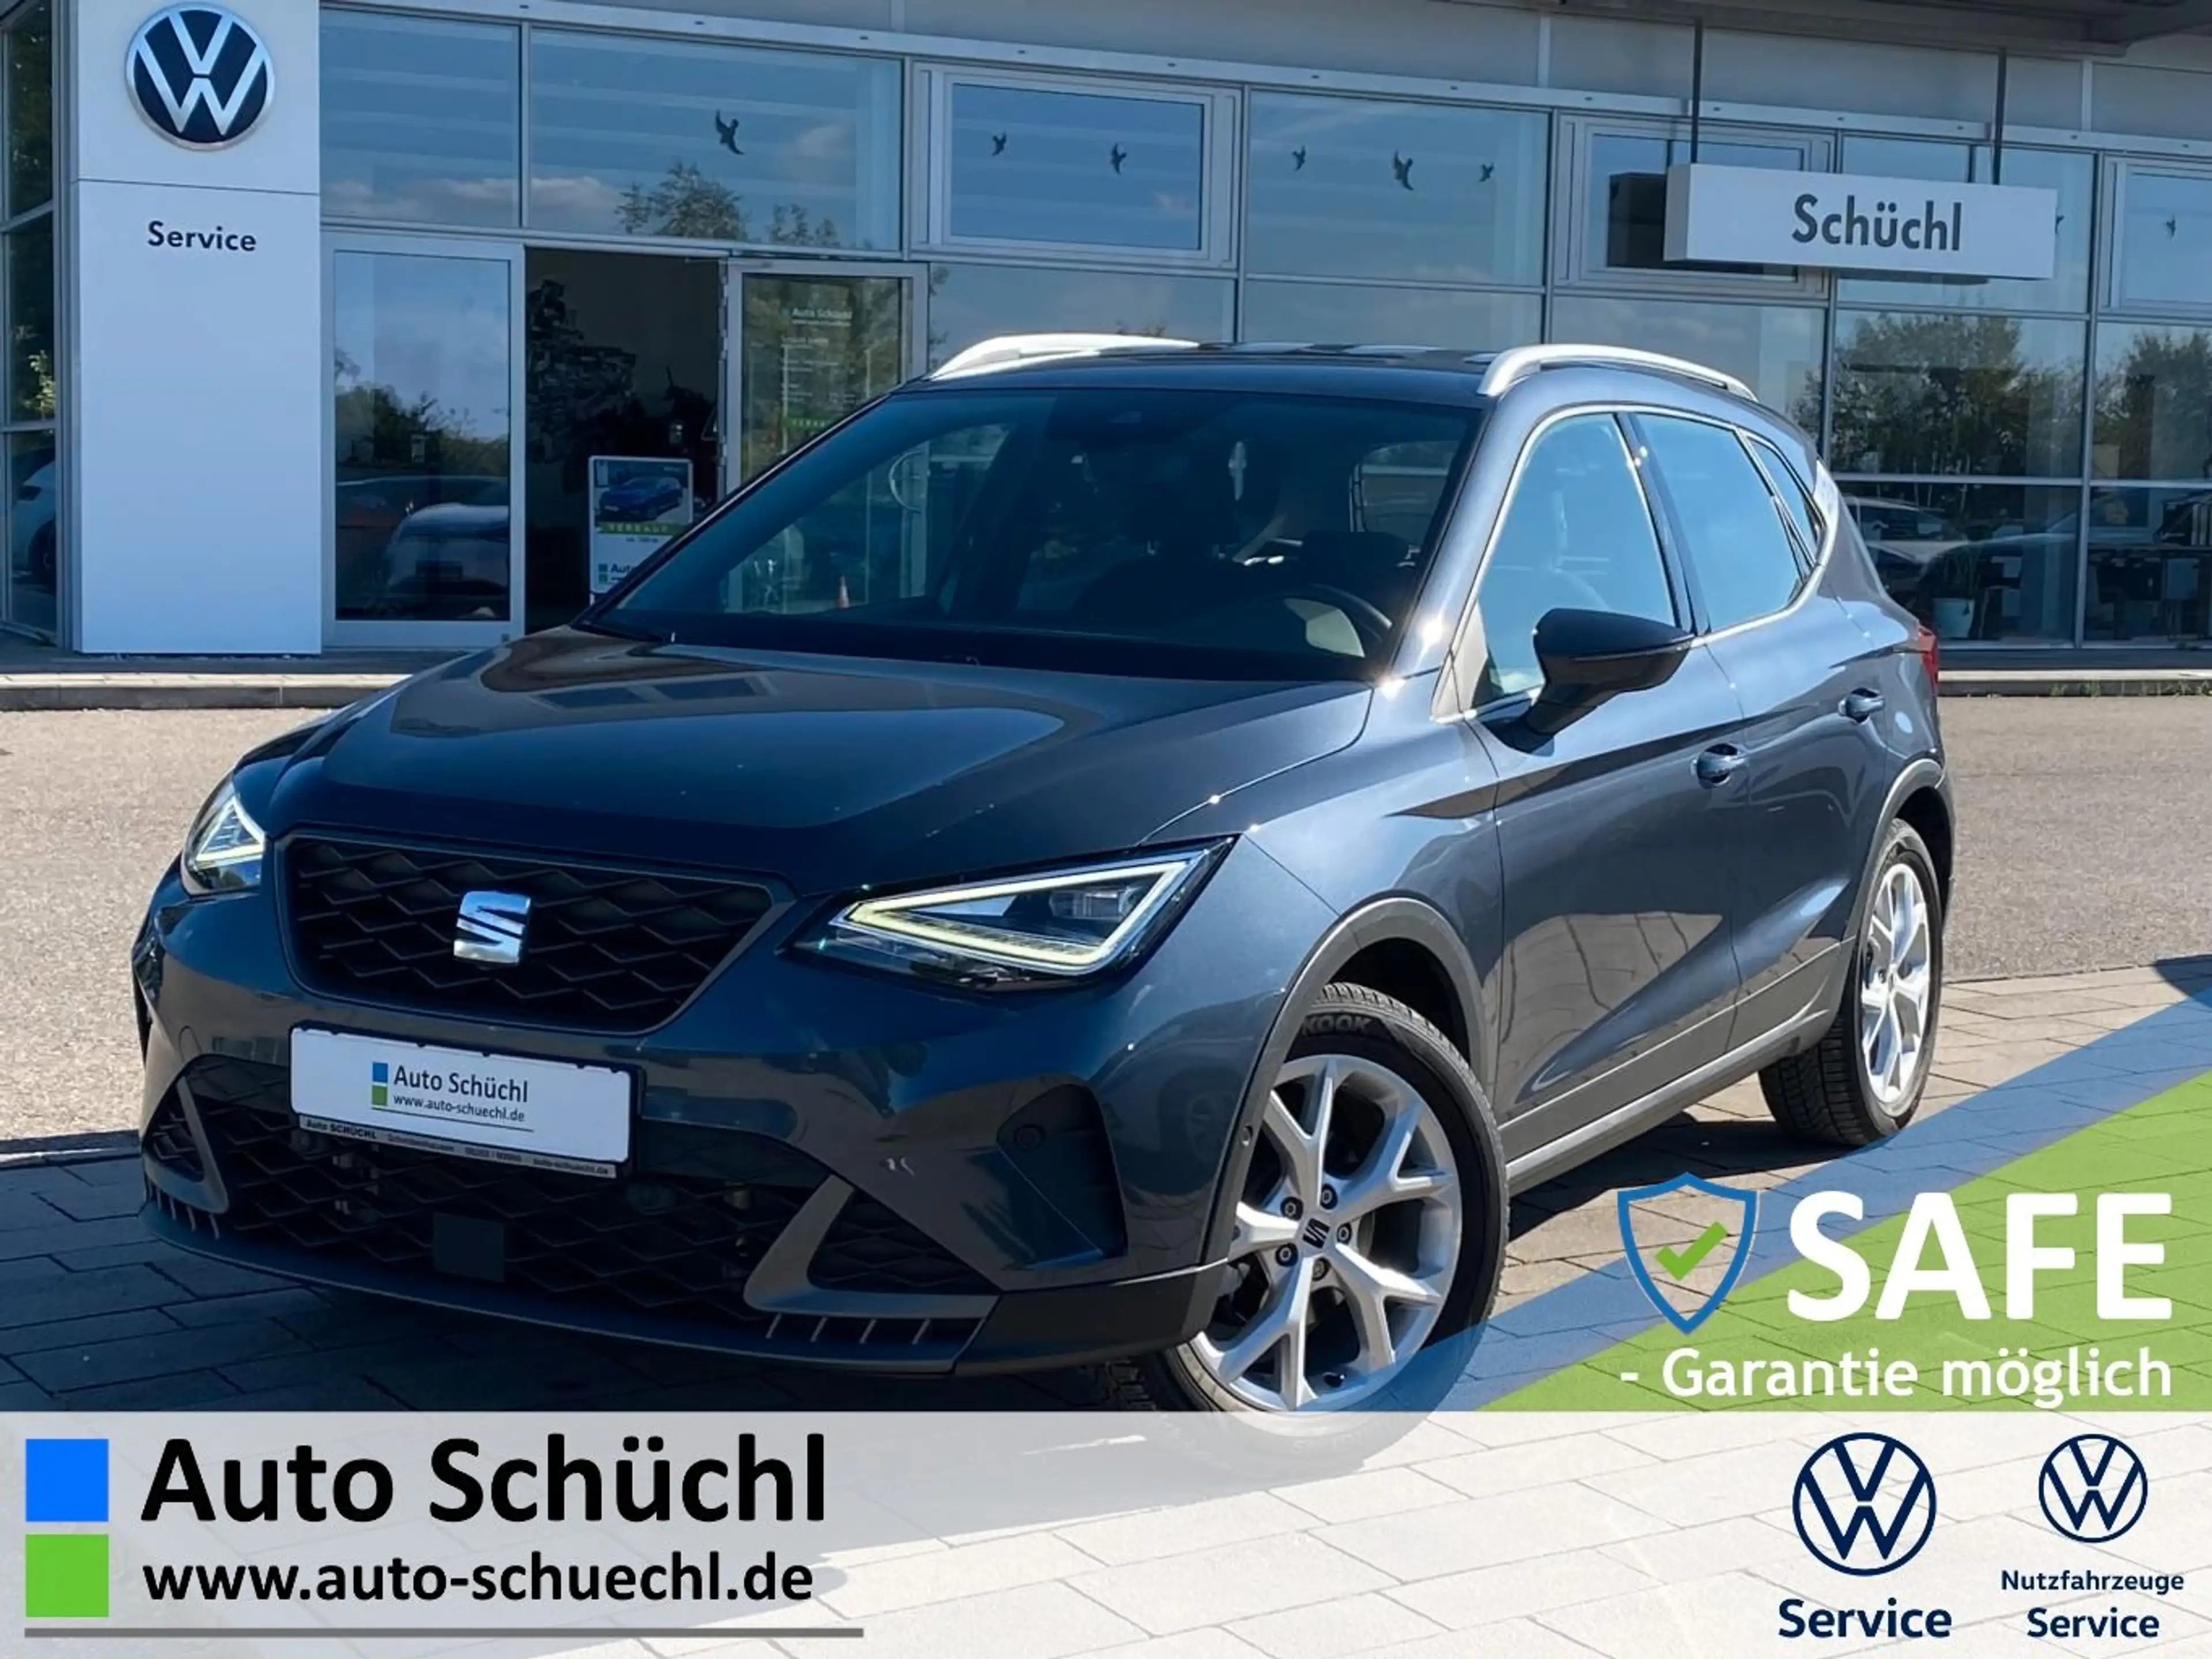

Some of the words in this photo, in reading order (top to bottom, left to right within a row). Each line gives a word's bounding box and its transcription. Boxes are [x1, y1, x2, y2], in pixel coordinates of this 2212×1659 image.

[148, 221, 256, 252] Service
[1791, 193, 1962, 252] Schüchl
[394, 1065, 443, 1091] Auto
[448, 1072, 528, 1103] Schüchl
[393, 1093, 525, 1123] www.auto-schuechl.de
